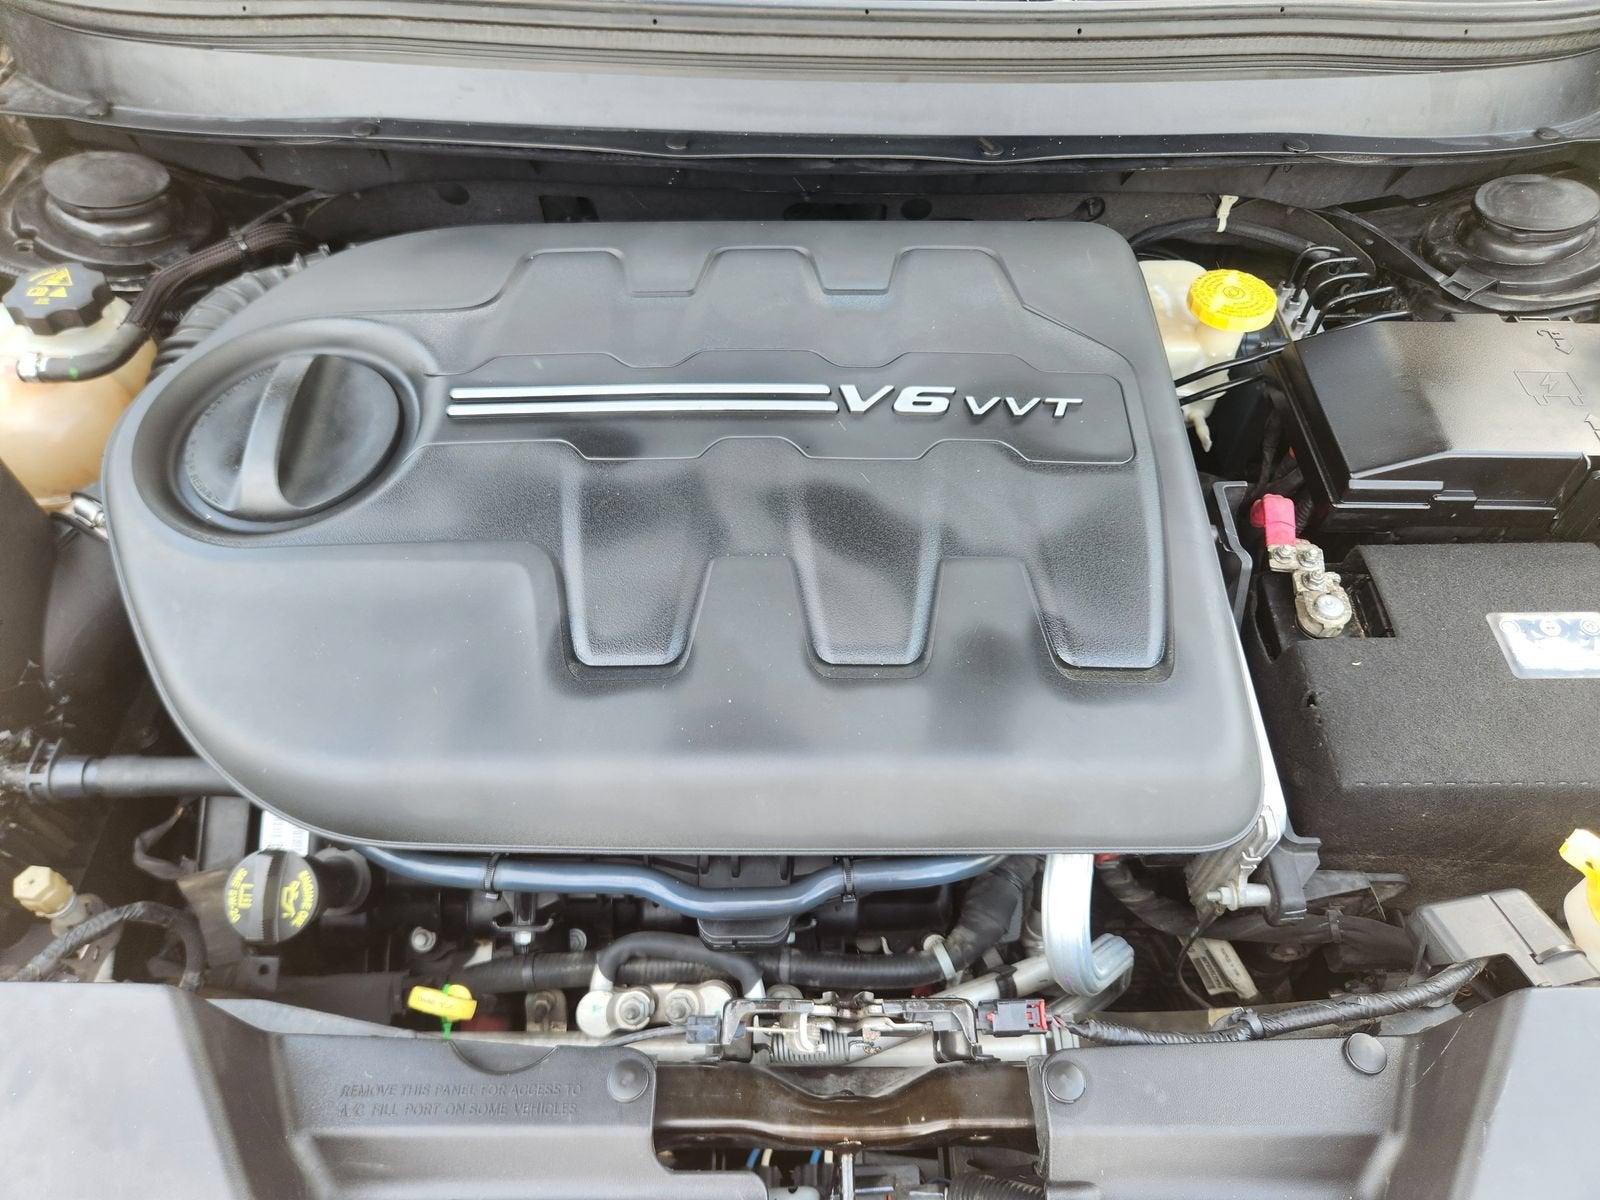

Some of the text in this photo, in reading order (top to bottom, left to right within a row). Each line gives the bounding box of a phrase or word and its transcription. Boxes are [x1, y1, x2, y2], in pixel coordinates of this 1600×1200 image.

[839, 384, 1083, 417] V6 VVT
[227, 889, 241, 924] 5W-20
[292, 869, 314, 928] ENGINE OIL
[340, 1083, 582, 1097] REMOVE THIS PANEL FOR ACCESS TO
[339, 1102, 578, 1117] A/C FILL PORT ON SOME VEHICLES
